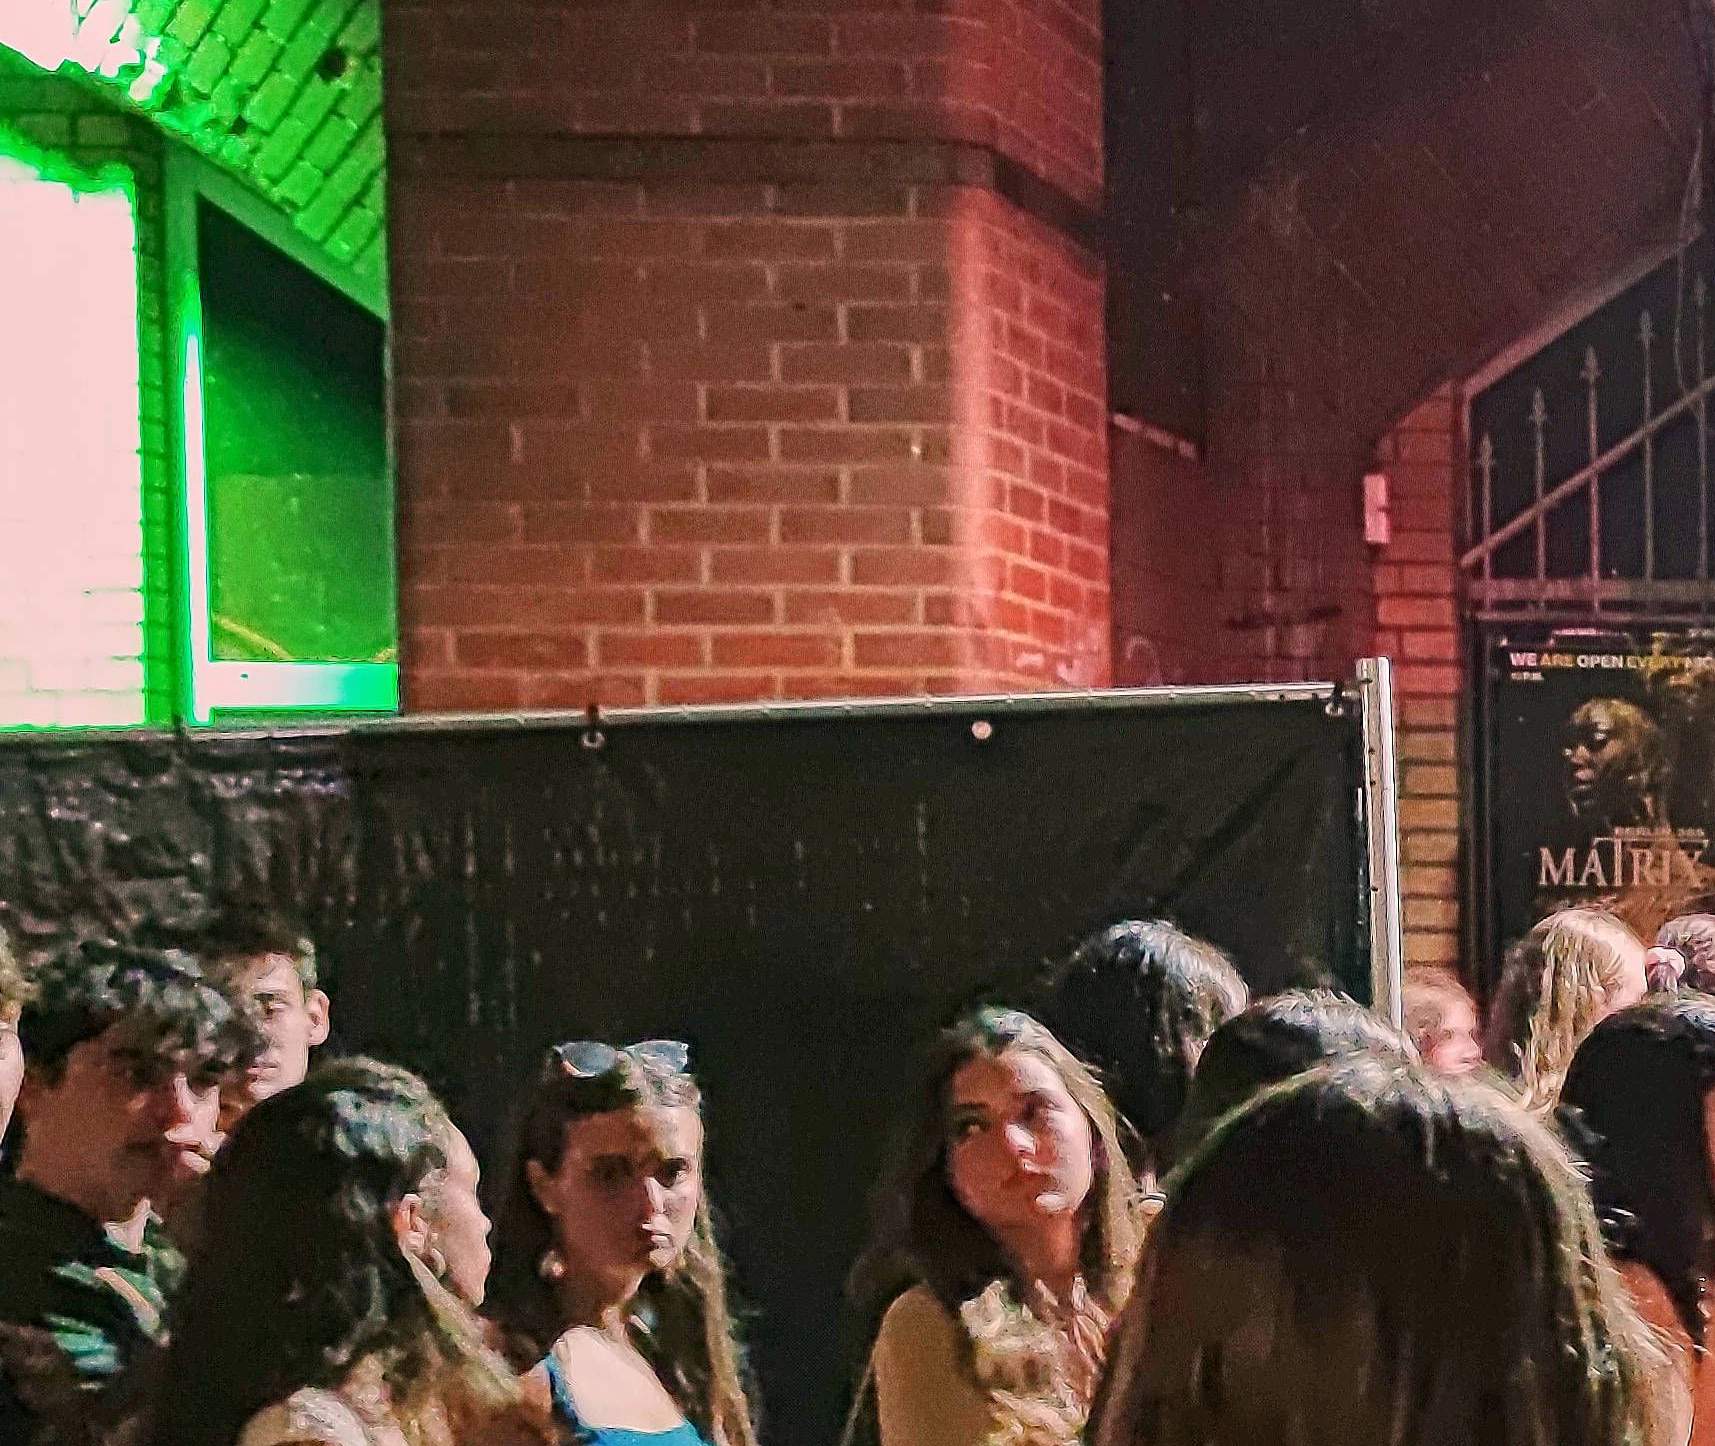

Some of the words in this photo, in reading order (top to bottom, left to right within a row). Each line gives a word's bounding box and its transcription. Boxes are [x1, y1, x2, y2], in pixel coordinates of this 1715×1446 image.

[1509, 652, 1538, 668] WE
[1576, 654, 1624, 669] OPEN
[1539, 836, 1709, 887] MATRIX
